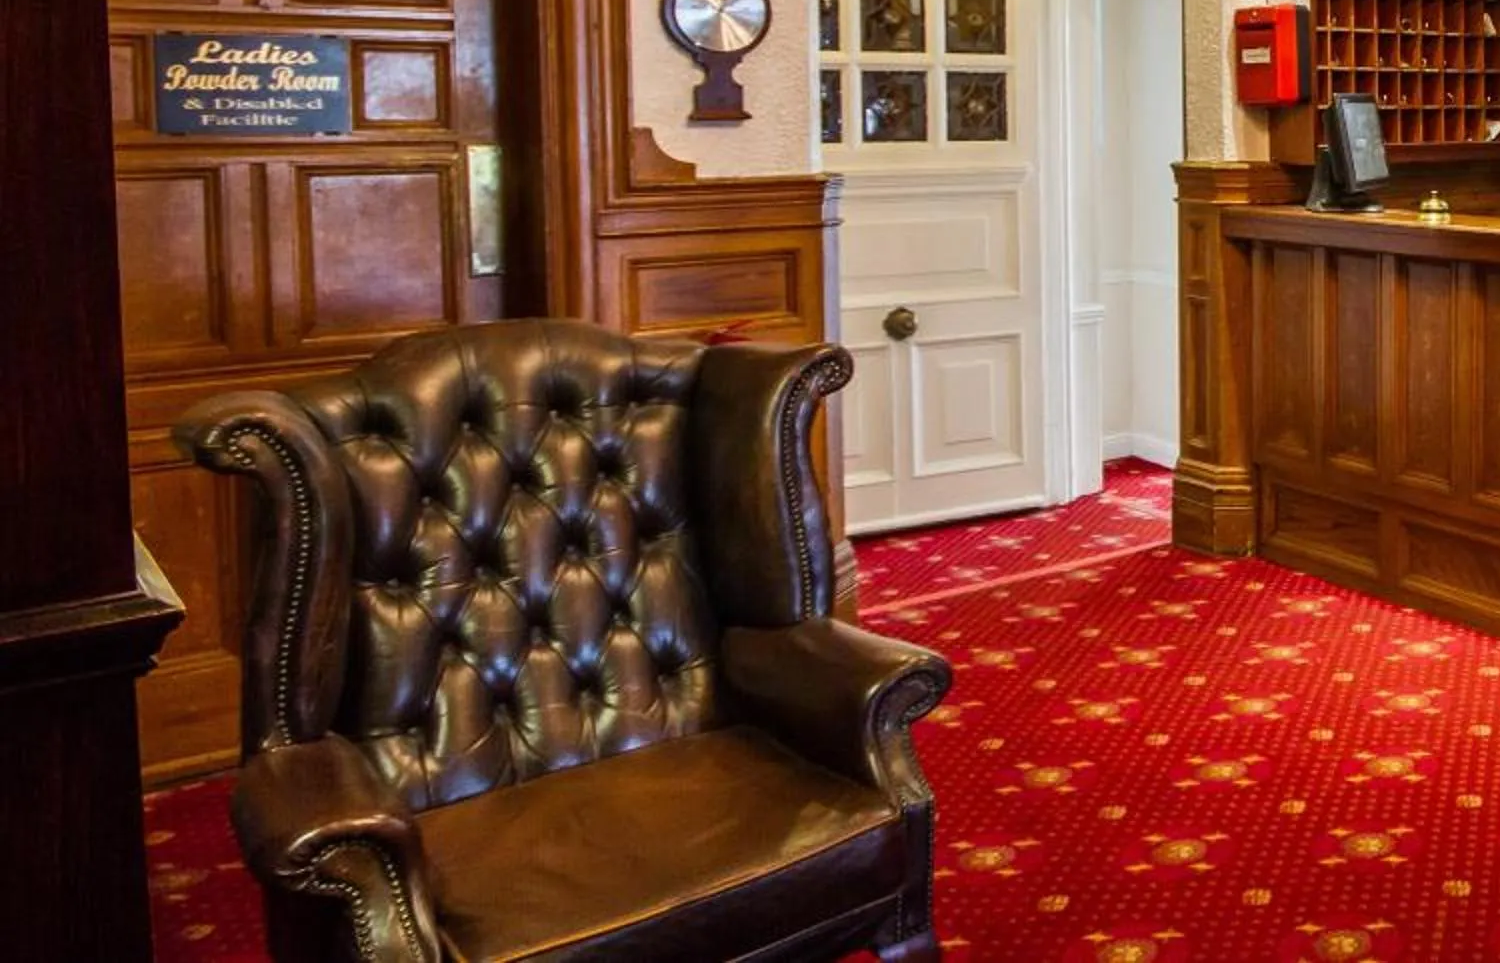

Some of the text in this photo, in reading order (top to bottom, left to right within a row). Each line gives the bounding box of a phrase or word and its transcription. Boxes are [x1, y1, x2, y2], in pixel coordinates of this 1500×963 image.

[189, 40, 318, 65] Ladies
[163, 64, 340, 91] Powder Room
[183, 97, 204, 110] &
